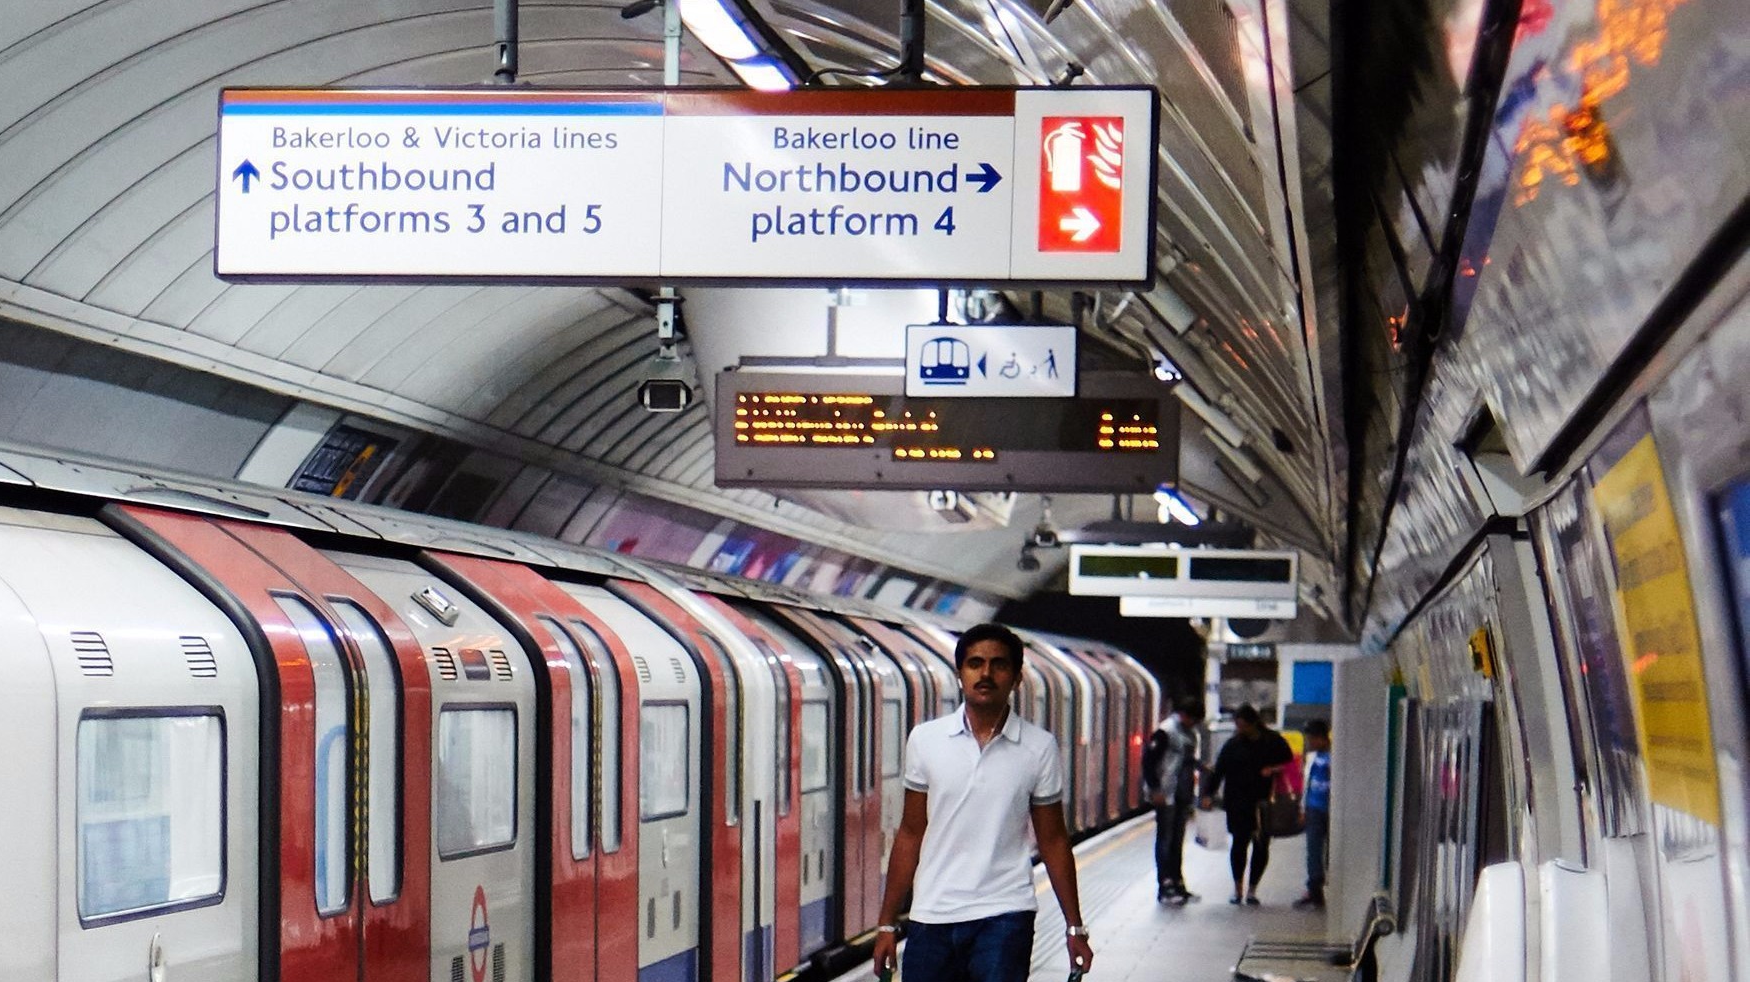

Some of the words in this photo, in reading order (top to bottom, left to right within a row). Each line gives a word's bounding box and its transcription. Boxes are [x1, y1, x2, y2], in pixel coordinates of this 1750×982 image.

[272, 126, 391, 150] Bakerloo
[402, 126, 420, 149] &
[434, 126, 542, 150] Victoria
[553, 127, 618, 150] lines
[773, 126, 897, 150] Bakerloo
[908, 127, 960, 150] line
[270, 161, 496, 191] Southbound
[722, 162, 959, 193] Northbound
[269, 203, 451, 240] platforms
[466, 204, 486, 234] 3
[501, 204, 567, 234] and
[583, 204, 603, 234] 5
[751, 205, 919, 243] platform
[934, 205, 956, 236] 4
